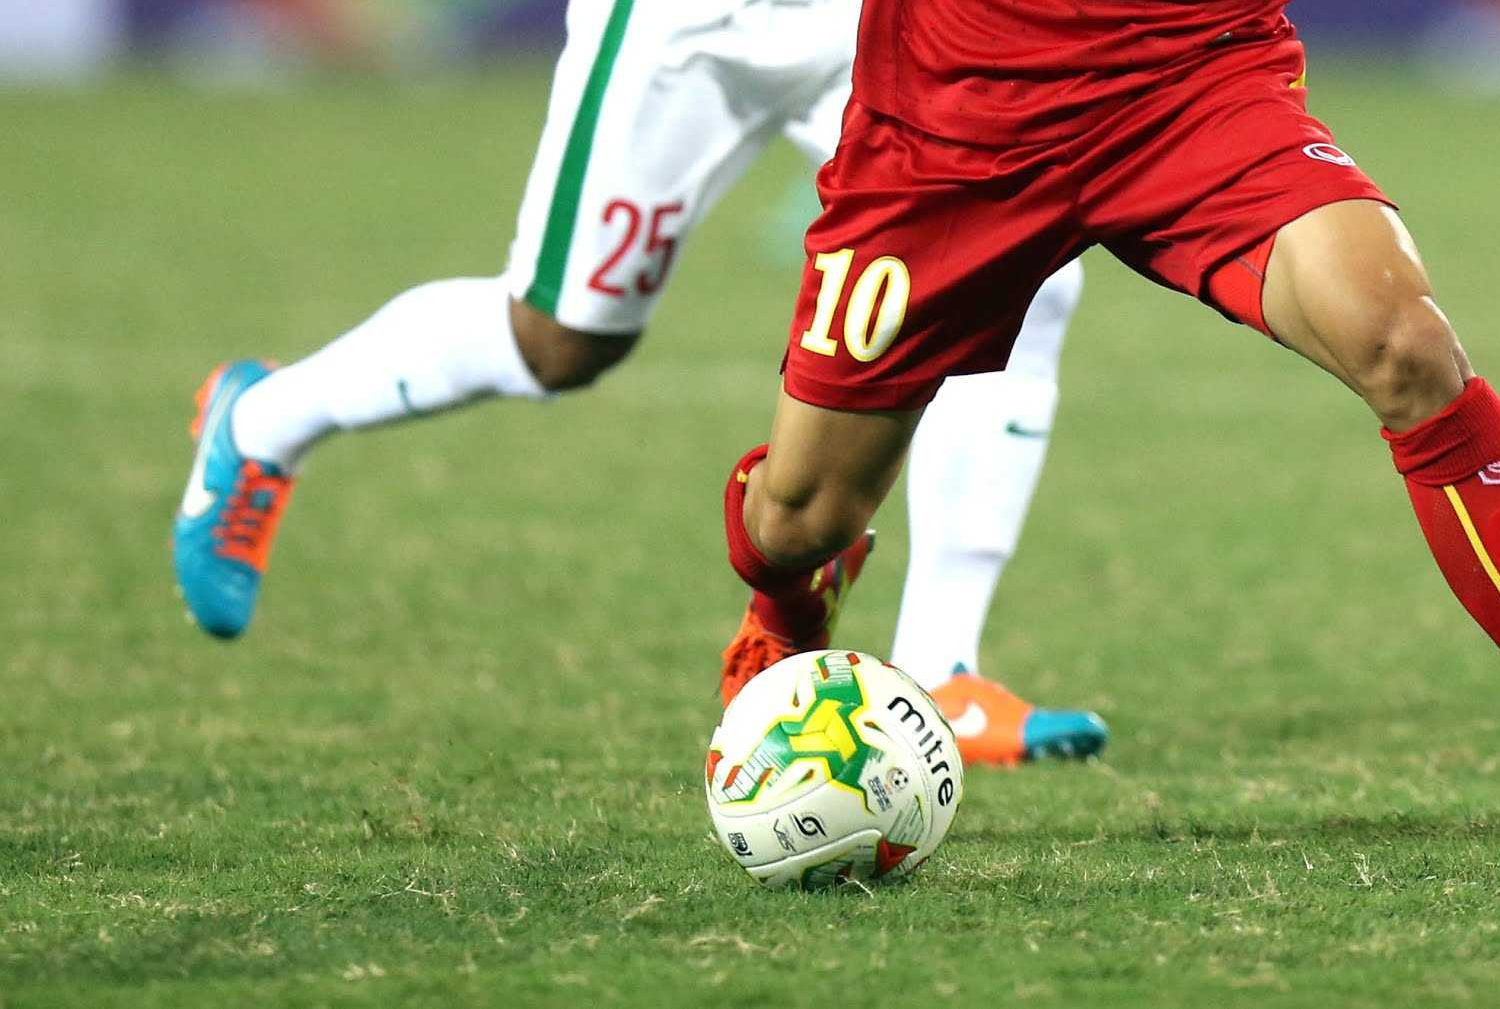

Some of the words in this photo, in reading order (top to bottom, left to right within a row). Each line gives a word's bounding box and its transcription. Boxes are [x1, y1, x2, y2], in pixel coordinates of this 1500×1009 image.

[586, 197, 684, 297] 25
[800, 248, 911, 362] 10
[887, 695, 954, 808] mitre
